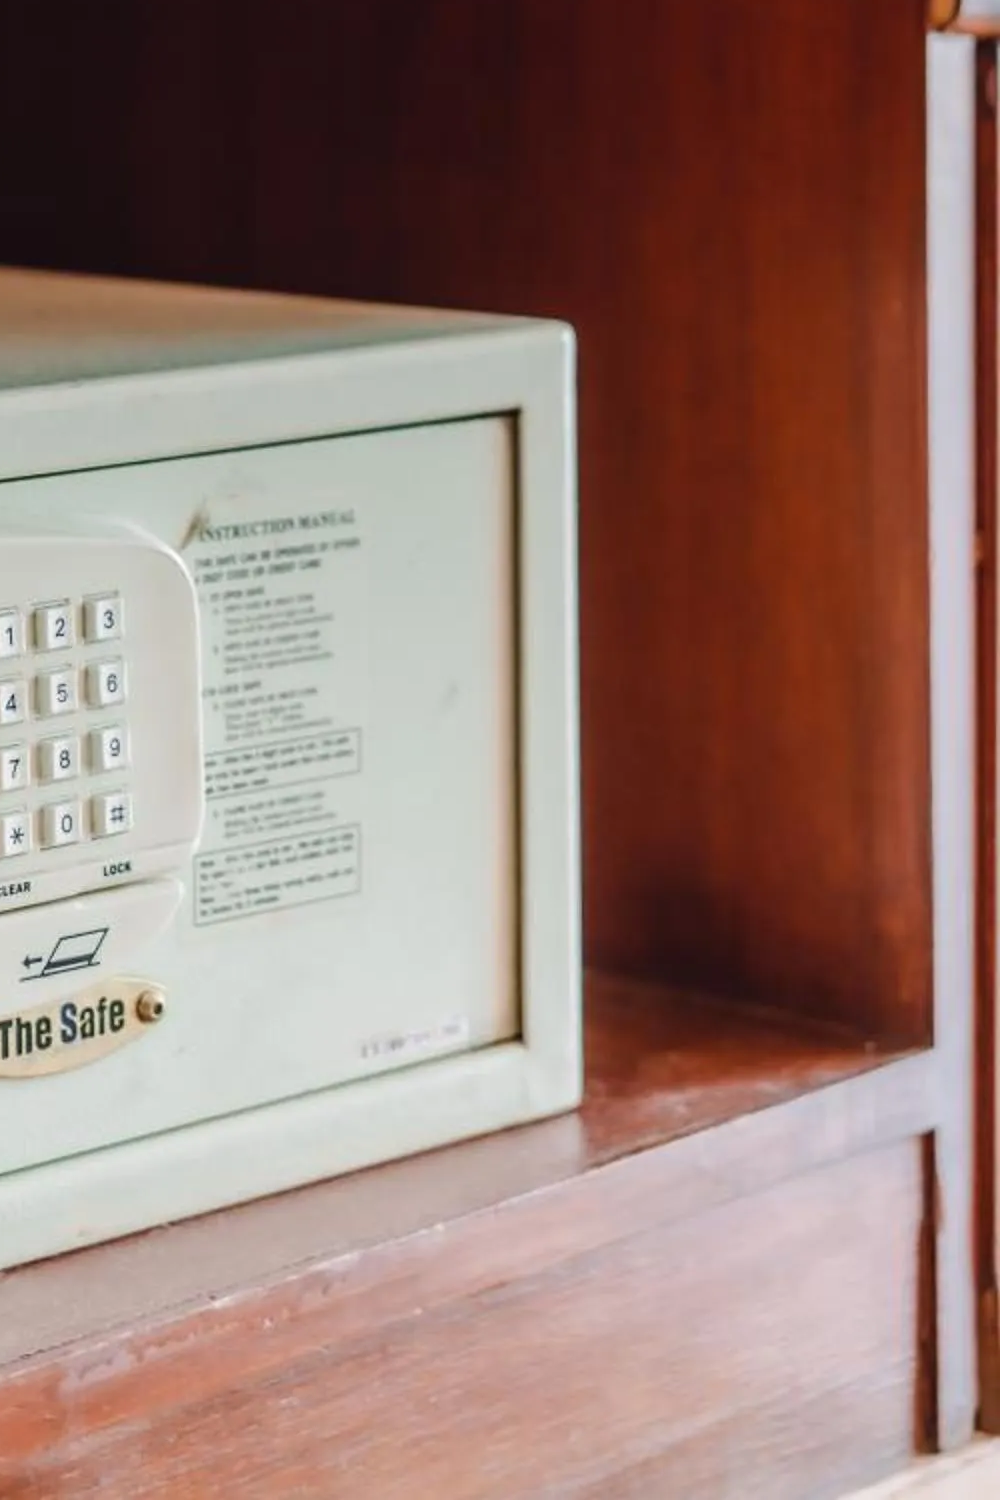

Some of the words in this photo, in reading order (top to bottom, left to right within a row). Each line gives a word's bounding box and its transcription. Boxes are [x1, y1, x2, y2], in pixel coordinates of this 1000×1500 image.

[6, 627, 14, 645] 1
[55, 618, 65, 638] 2
[103, 609, 115, 629] 3
[5, 694, 17, 712] 4
[56, 683, 68, 703] 5
[106, 673, 118, 693] 6
[9, 759, 20, 778] 7
[59, 750, 70, 769] 8
[109, 738, 121, 757] 9
[61, 815, 73, 833] 0
[103, 860, 132, 877] LOCK
[60, 996, 126, 1045] Safe
